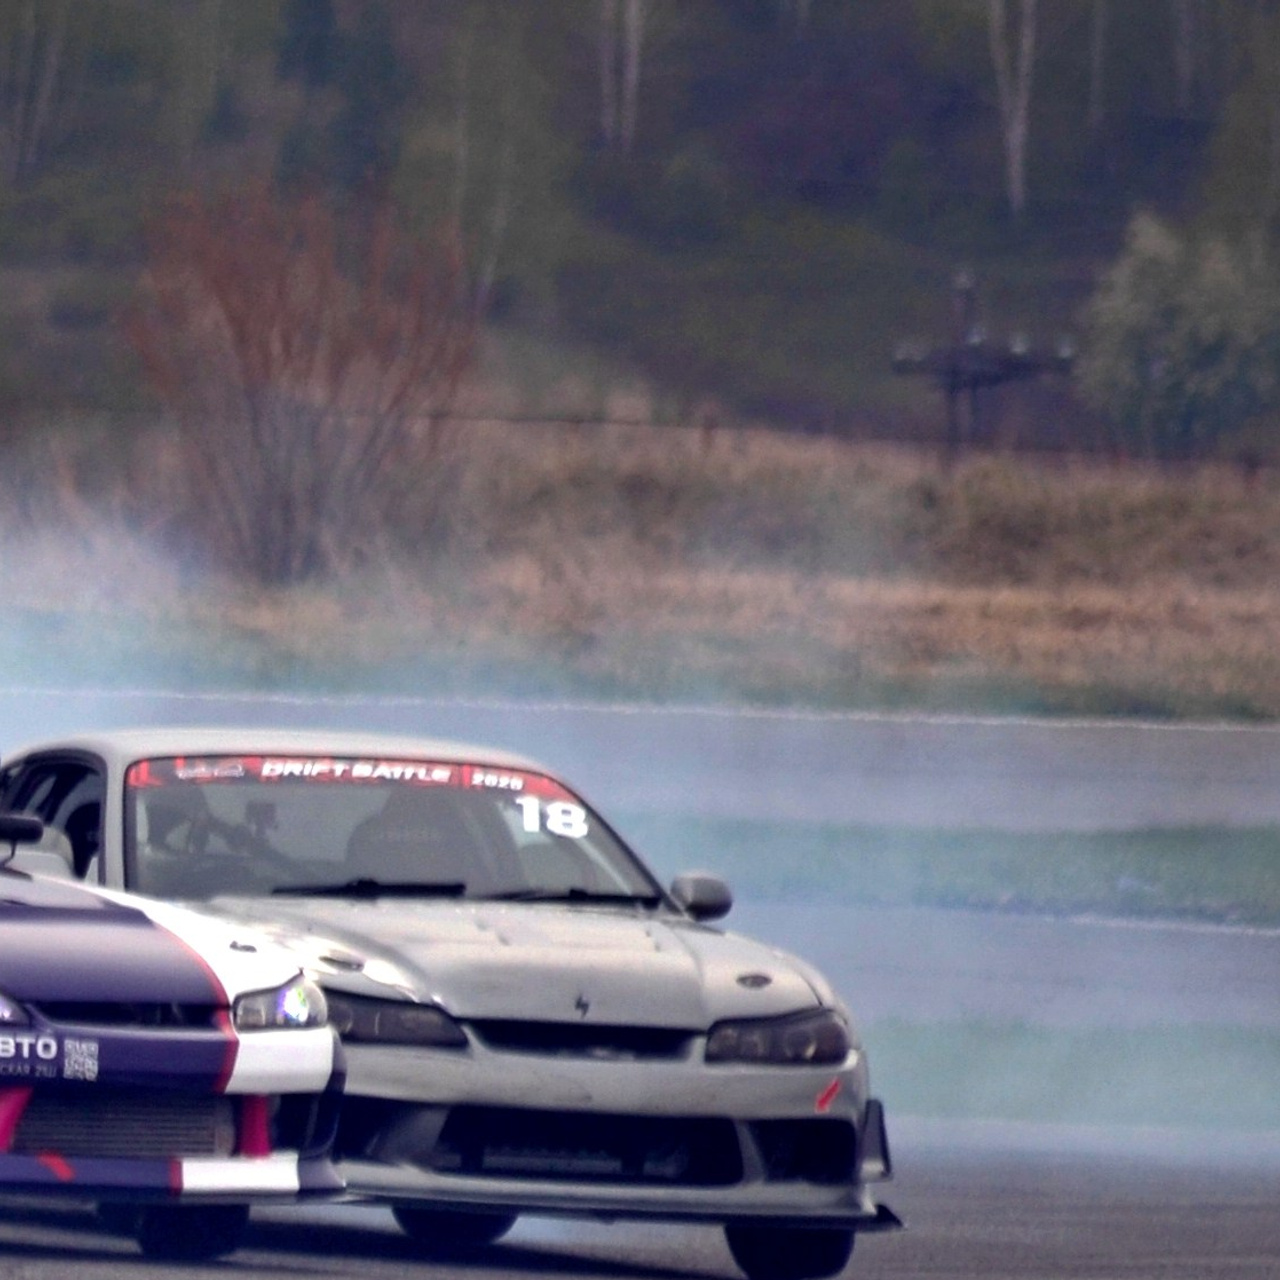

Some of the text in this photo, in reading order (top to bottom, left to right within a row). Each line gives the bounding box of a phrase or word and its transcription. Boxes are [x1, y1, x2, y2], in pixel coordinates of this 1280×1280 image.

[261, 759, 350, 777] DRIFT
[352, 761, 451, 783] BATTLE
[516, 796, 589, 839] 18
